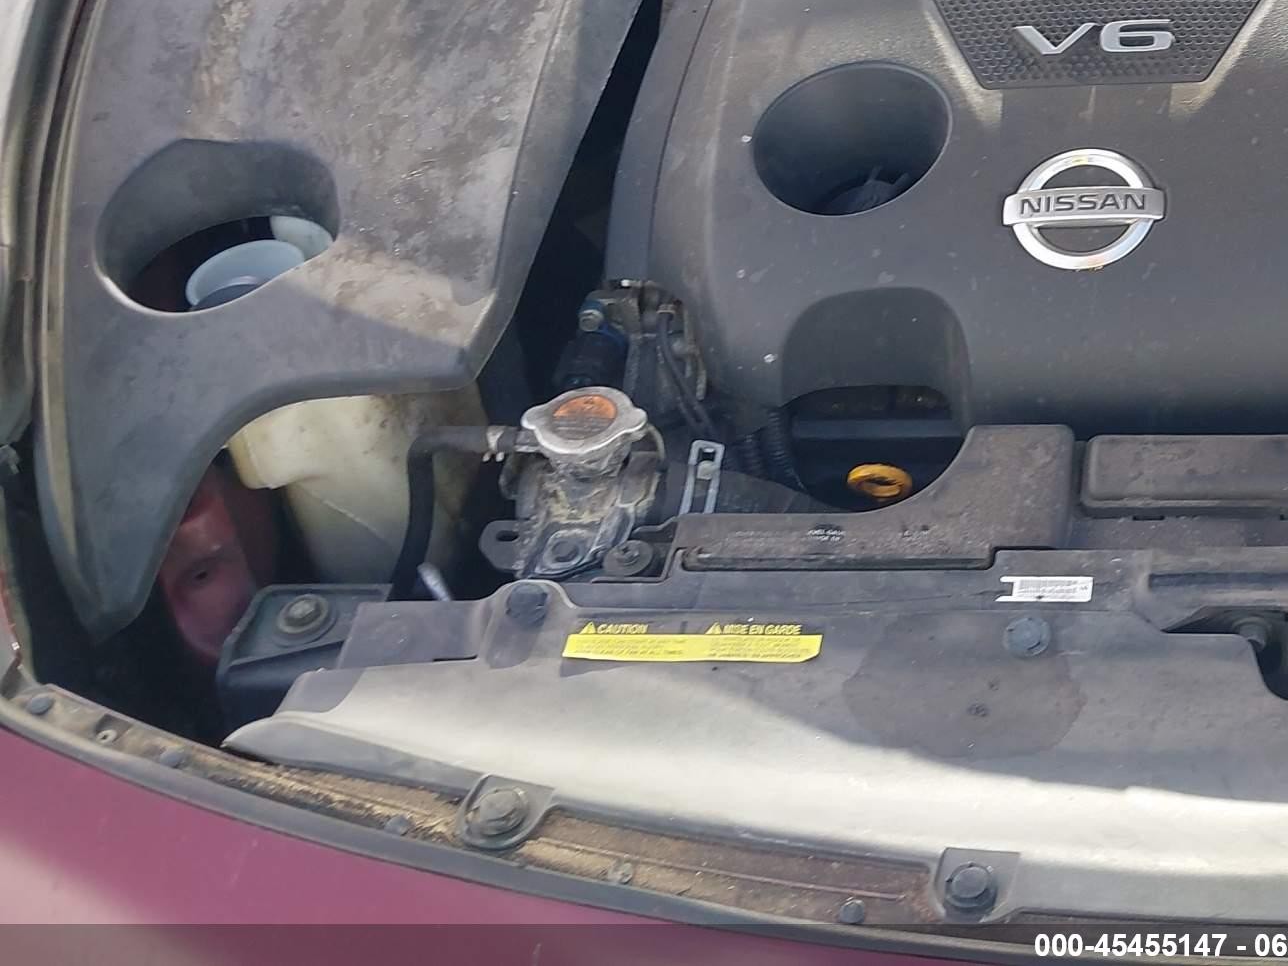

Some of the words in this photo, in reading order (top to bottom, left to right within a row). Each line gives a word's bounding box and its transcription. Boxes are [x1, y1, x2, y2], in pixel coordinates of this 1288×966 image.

[1014, 19, 1176, 55] V6
[1020, 193, 1146, 215] NISSAN
[597, 624, 648, 634] CAUTION
[749, 624, 765, 634] EN
[765, 624, 803, 634] GARDE
